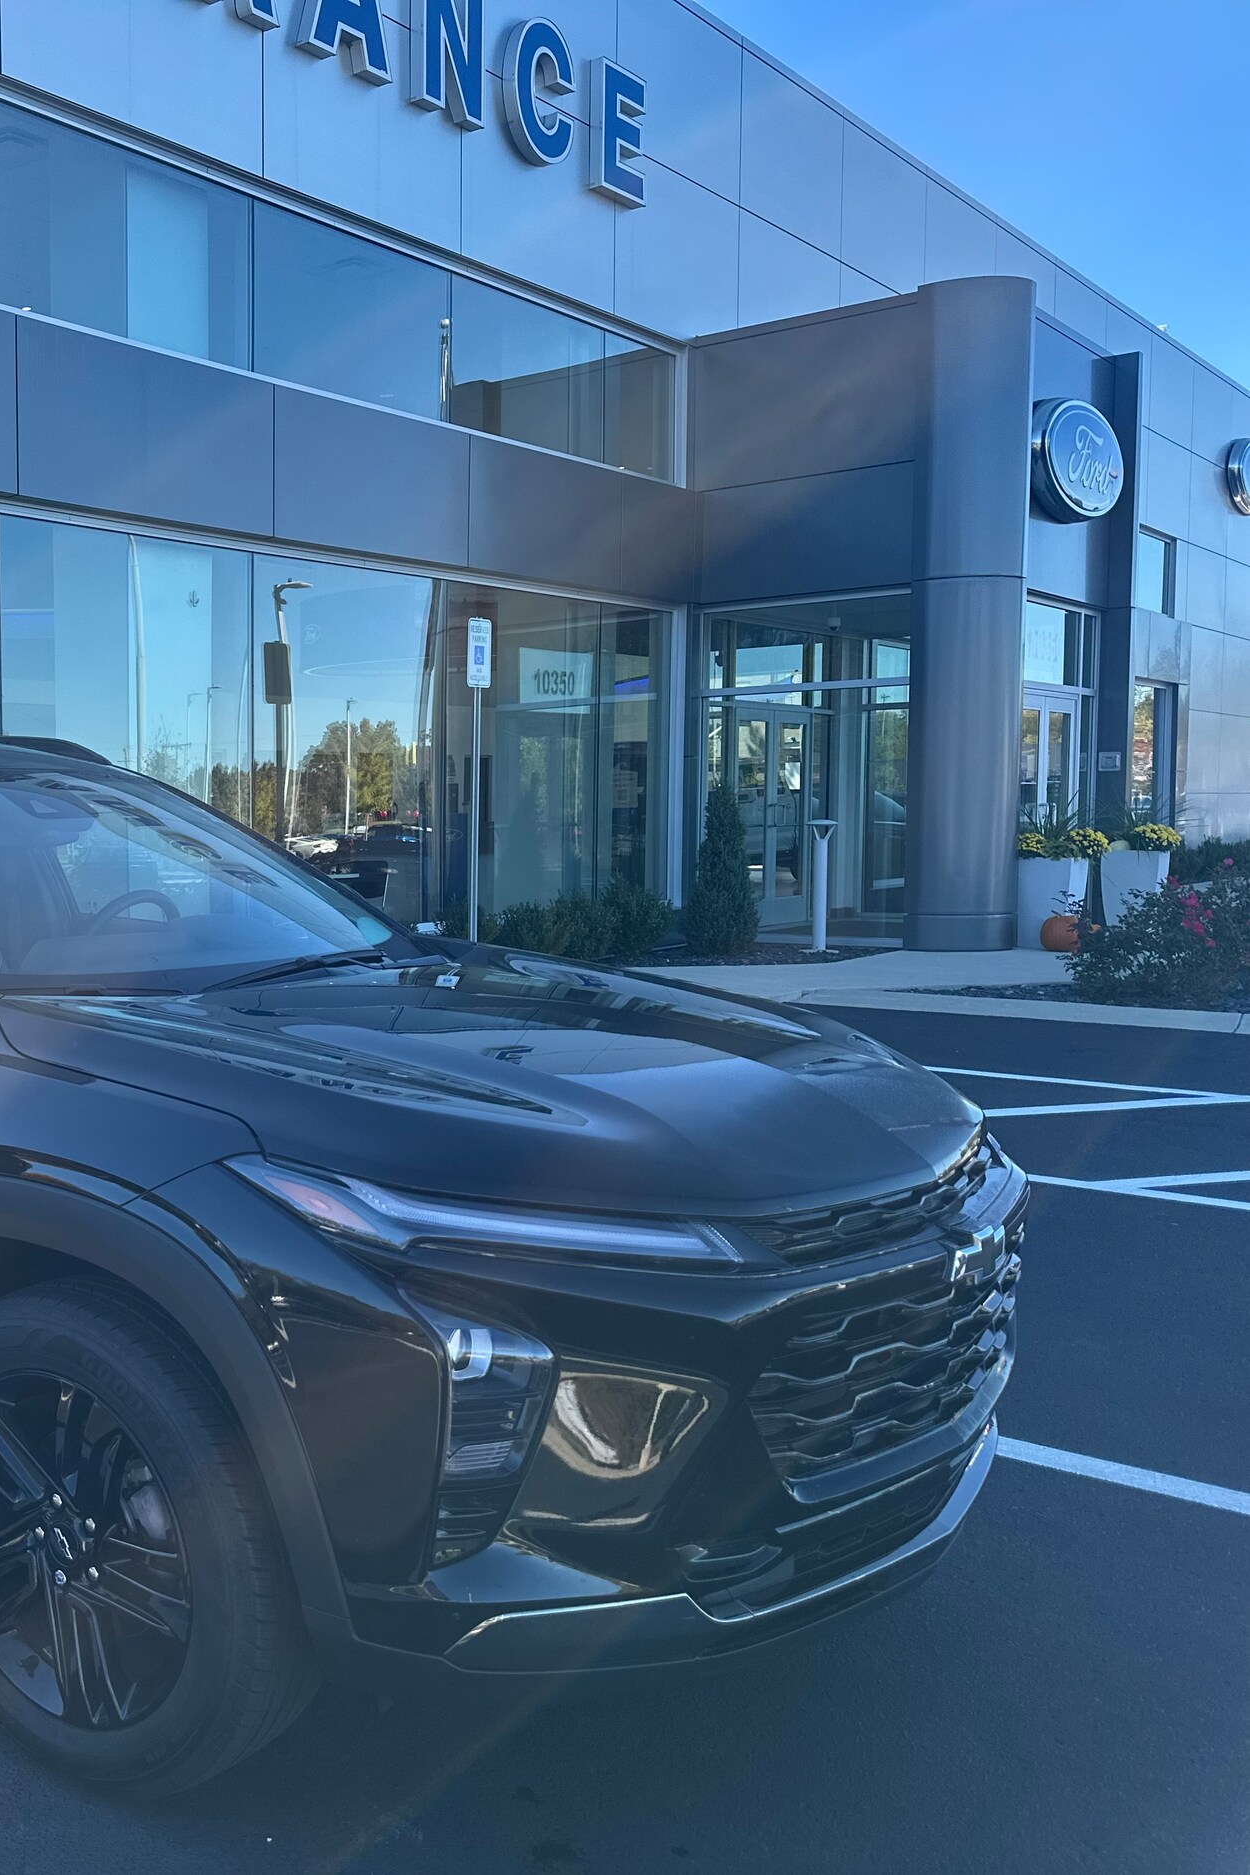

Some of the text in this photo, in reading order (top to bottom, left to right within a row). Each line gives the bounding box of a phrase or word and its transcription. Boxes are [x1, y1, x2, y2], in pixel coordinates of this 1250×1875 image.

[202, 0, 647, 208] ANCE
[1067, 424, 1117, 496] Ford
[471, 634, 487, 644] PARKING
[533, 668, 575, 696] 10350
